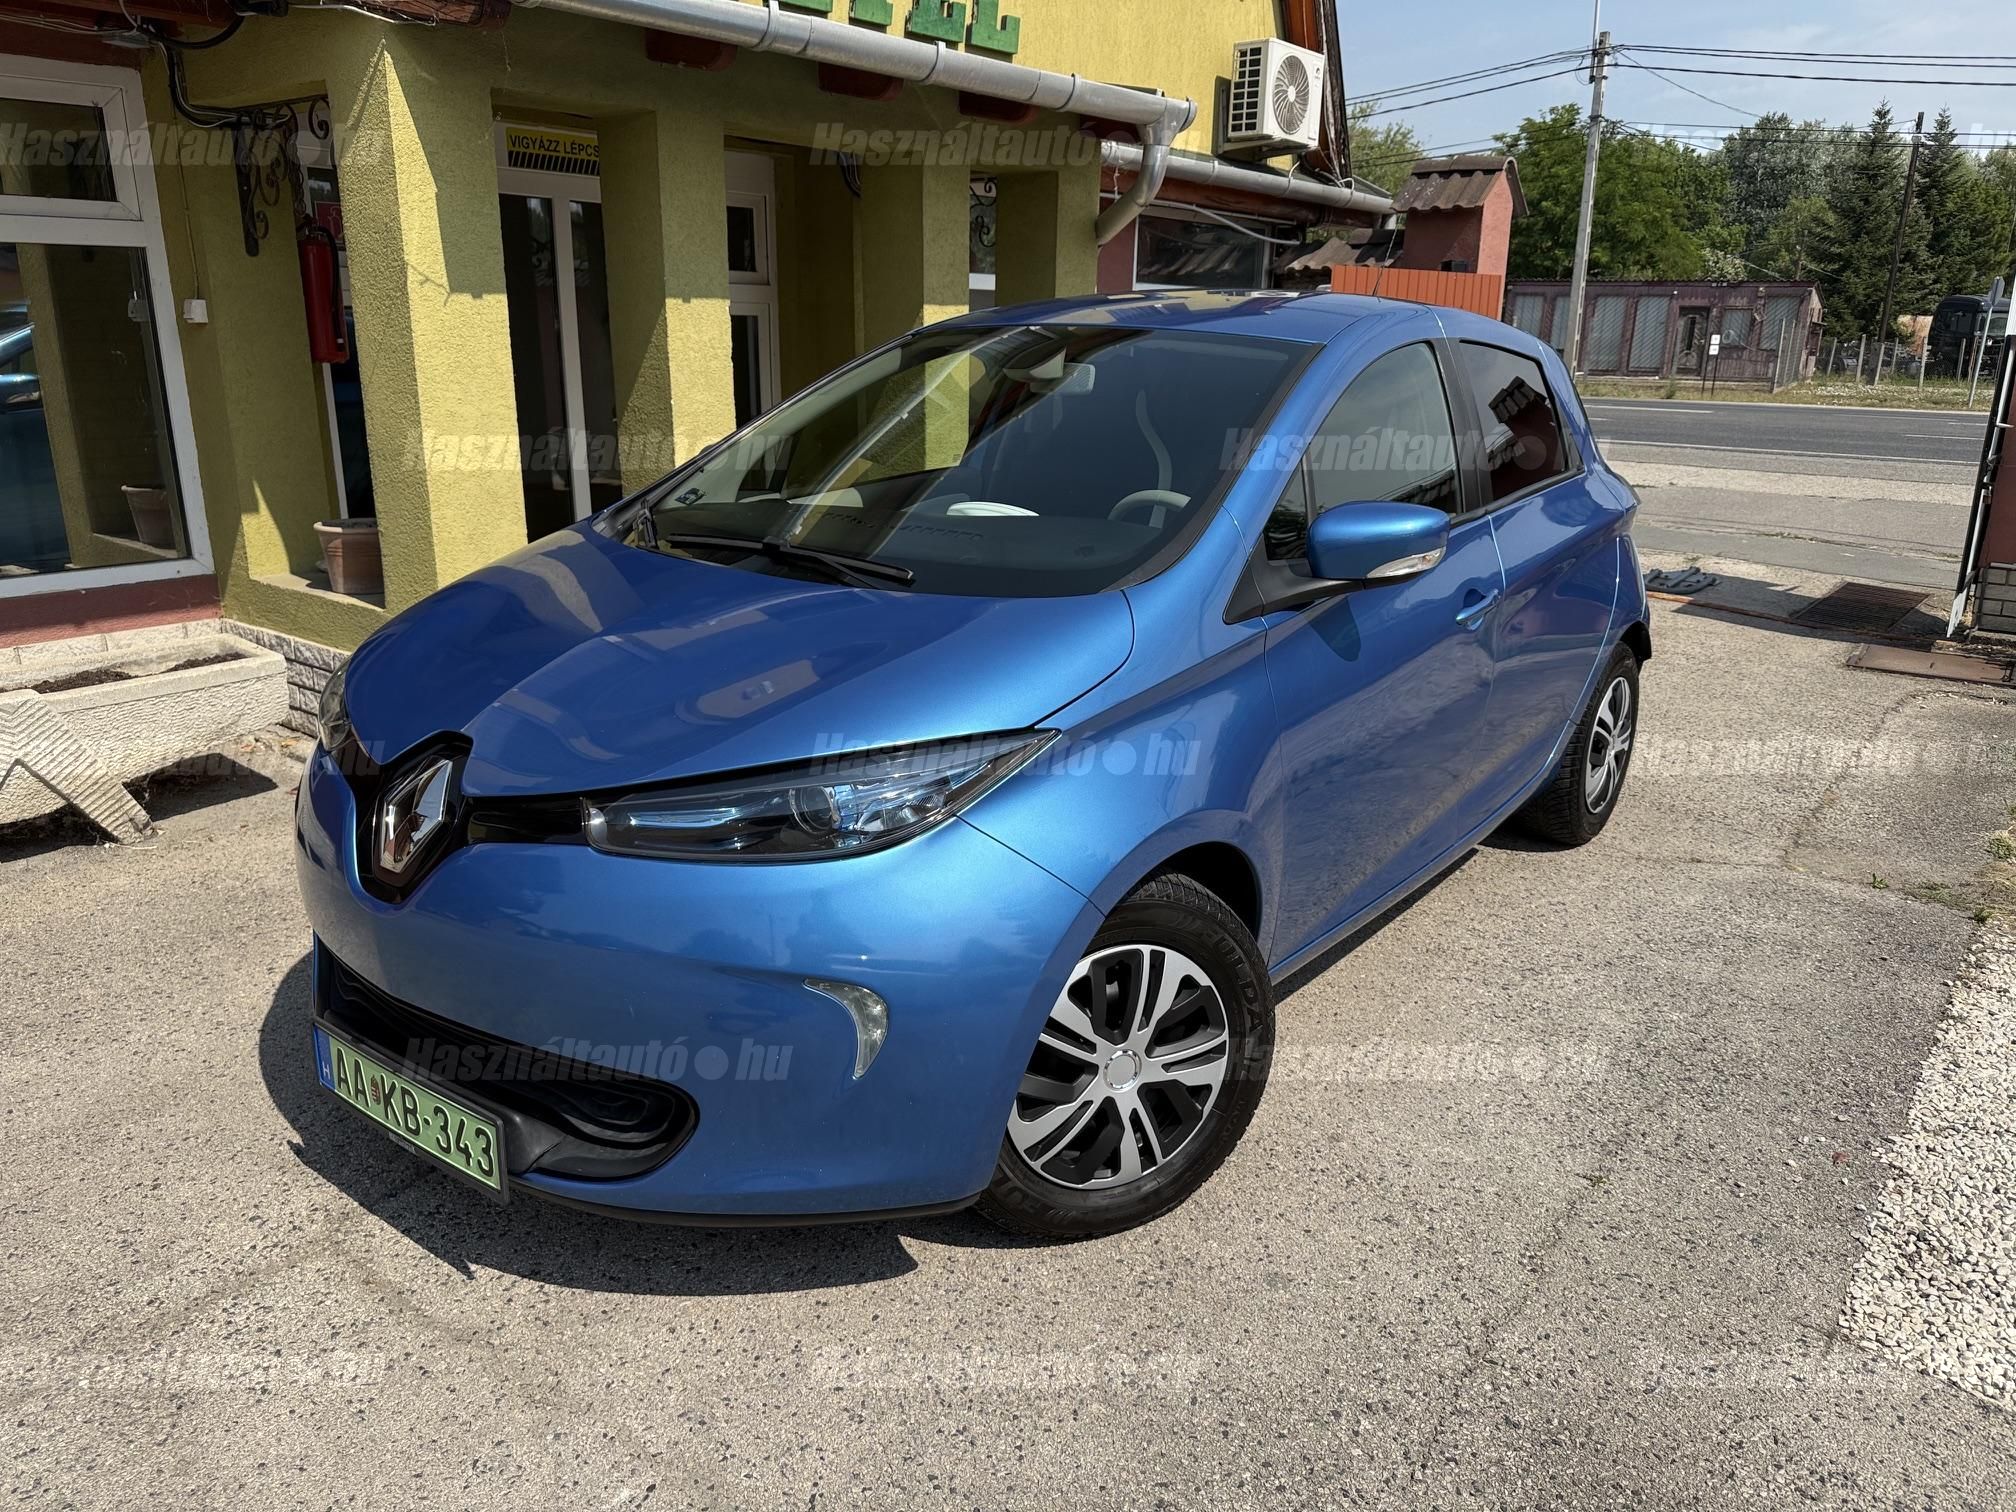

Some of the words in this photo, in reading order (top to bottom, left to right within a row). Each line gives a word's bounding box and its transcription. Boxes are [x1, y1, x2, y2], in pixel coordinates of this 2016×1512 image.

[509, 134, 561, 153] VIGYÁZZ
[336, 1046, 372, 1109] AA
[380, 1072, 495, 1179] KB-343
